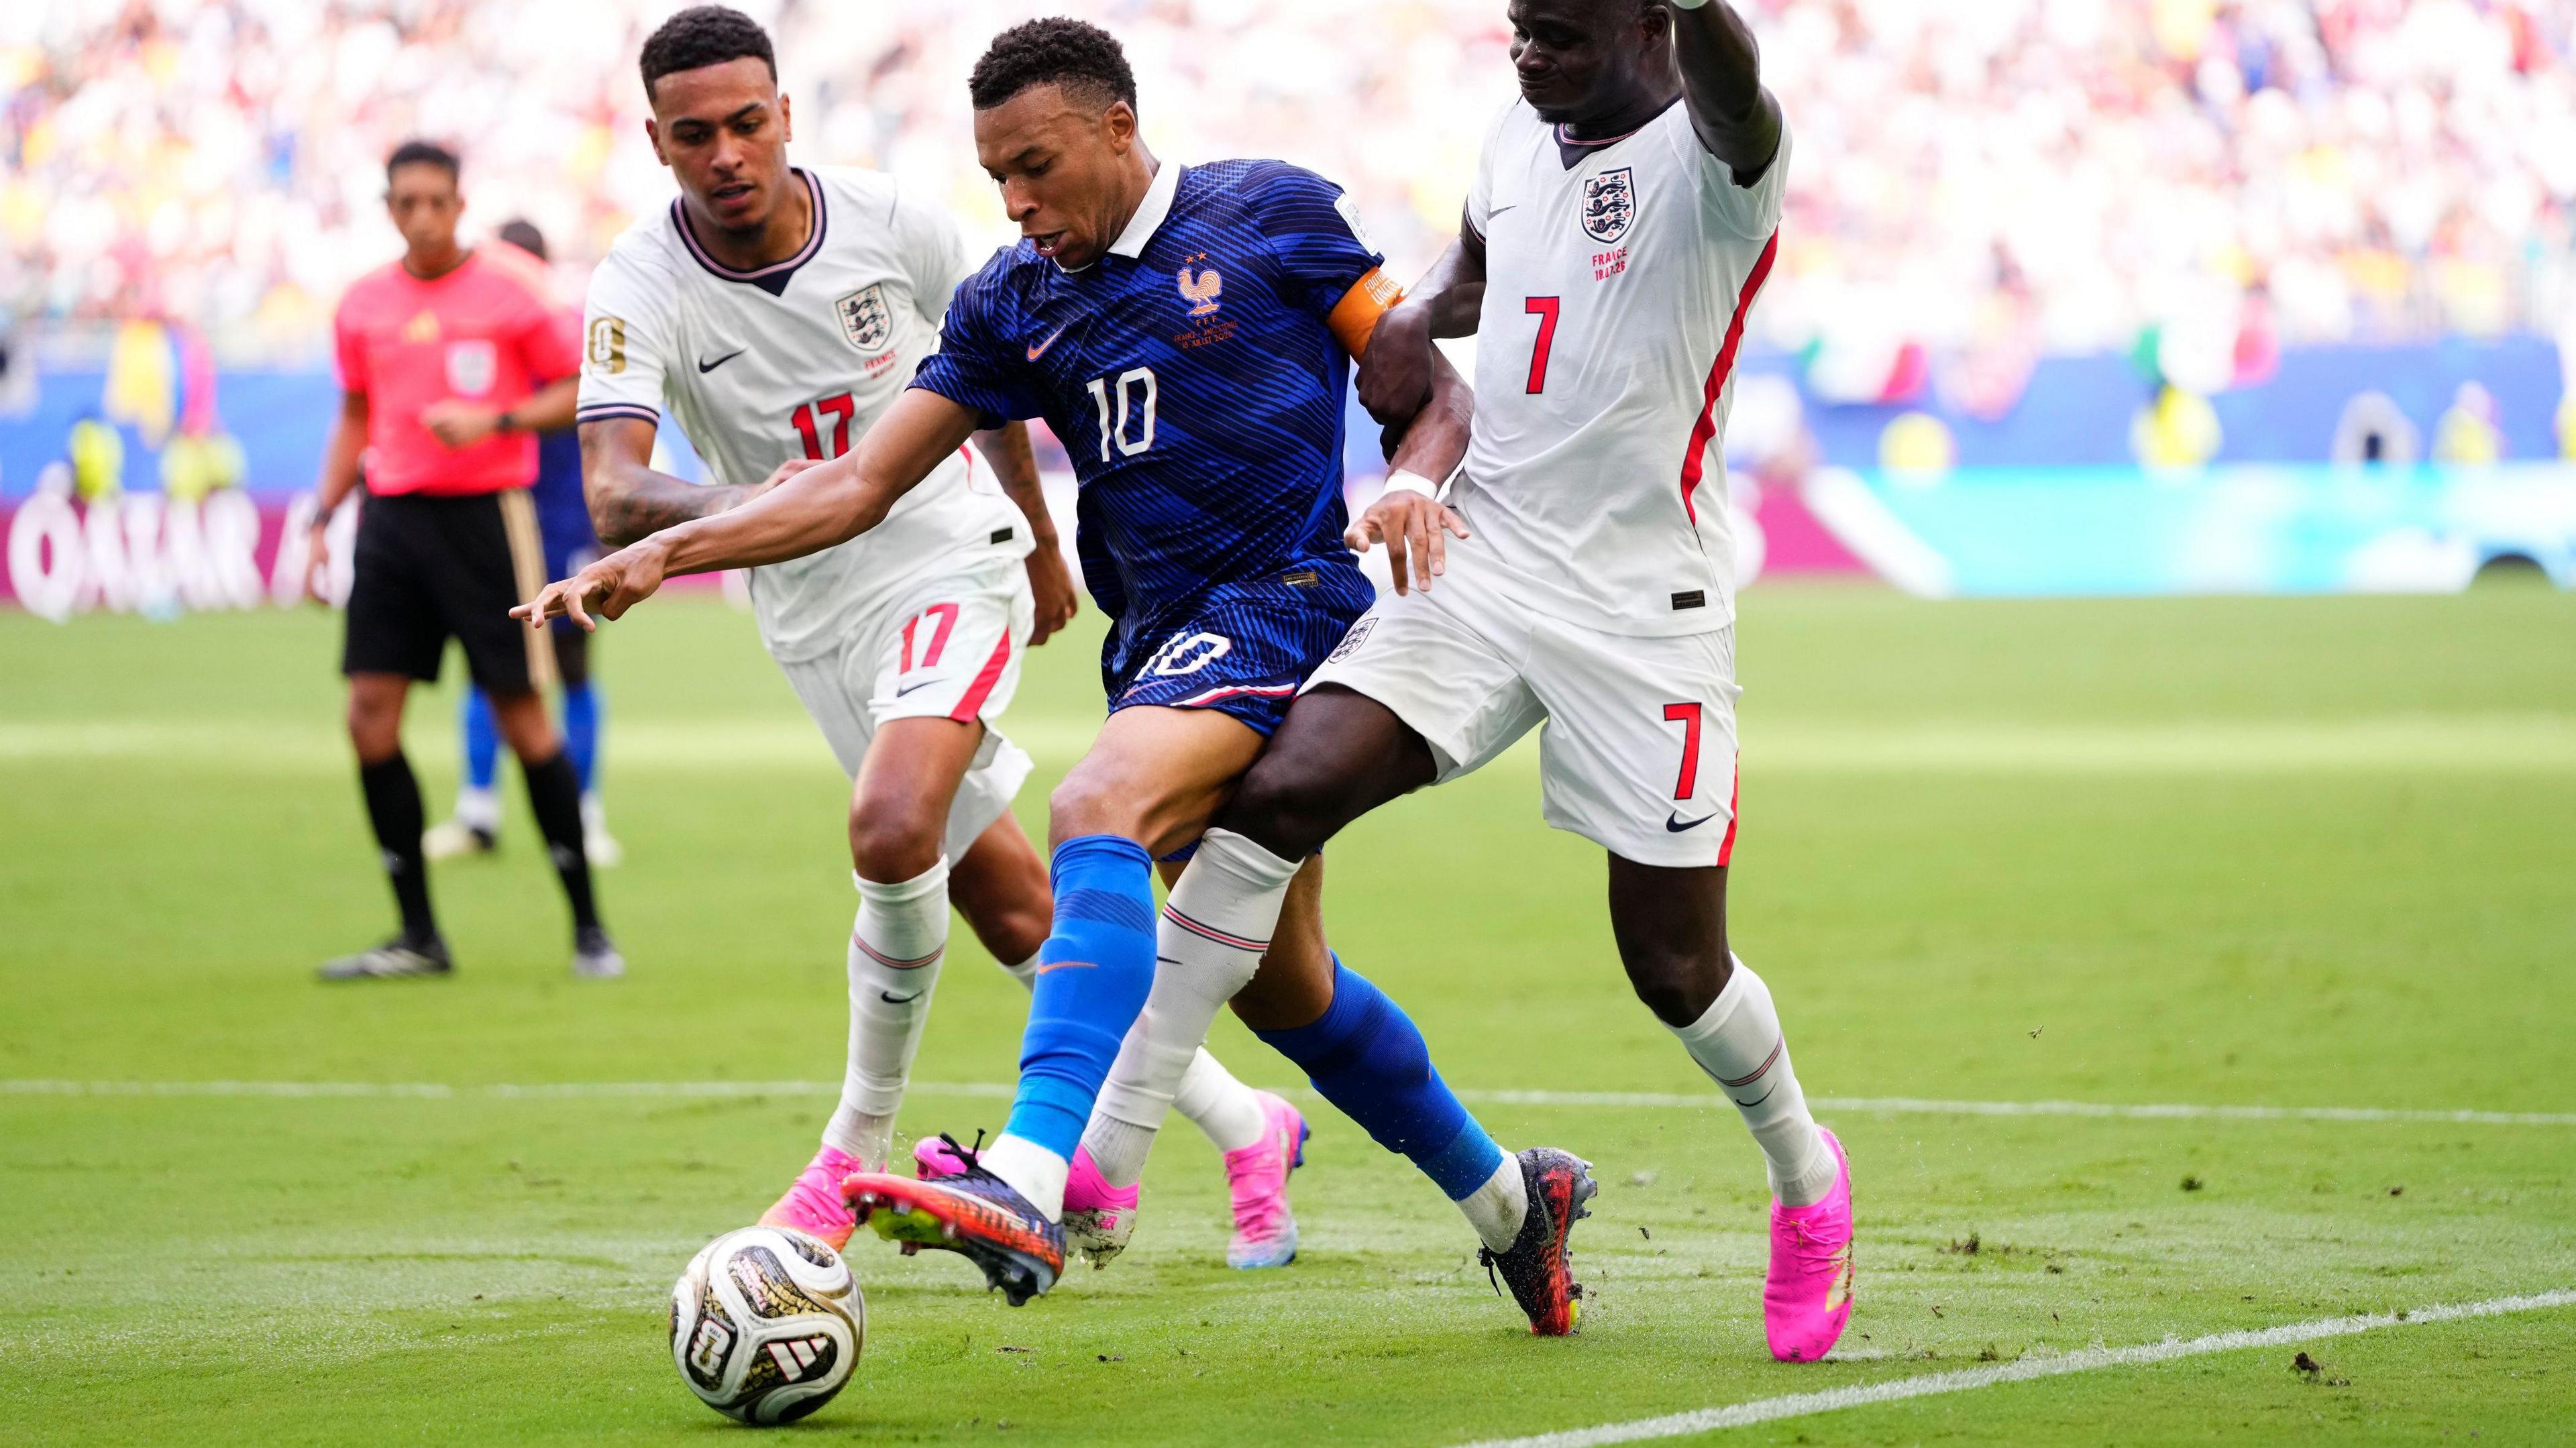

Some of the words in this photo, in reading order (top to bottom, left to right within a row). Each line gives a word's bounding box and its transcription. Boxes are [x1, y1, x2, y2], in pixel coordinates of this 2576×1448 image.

[1592, 245, 1627, 267] FRANCE
[1595, 260, 1625, 281] 18.07.26
[1174, 331, 1195, 342] FRANCE
[1214, 331, 1234, 342] 2026
[1525, 296, 1560, 394] 7
[791, 392, 855, 460] 17
[1086, 366, 1157, 462] 10
[900, 602, 959, 675] 17
[1134, 631, 1231, 681] 10
[1663, 702, 1702, 800] 7
[709, 1326, 721, 1339] FIFA
